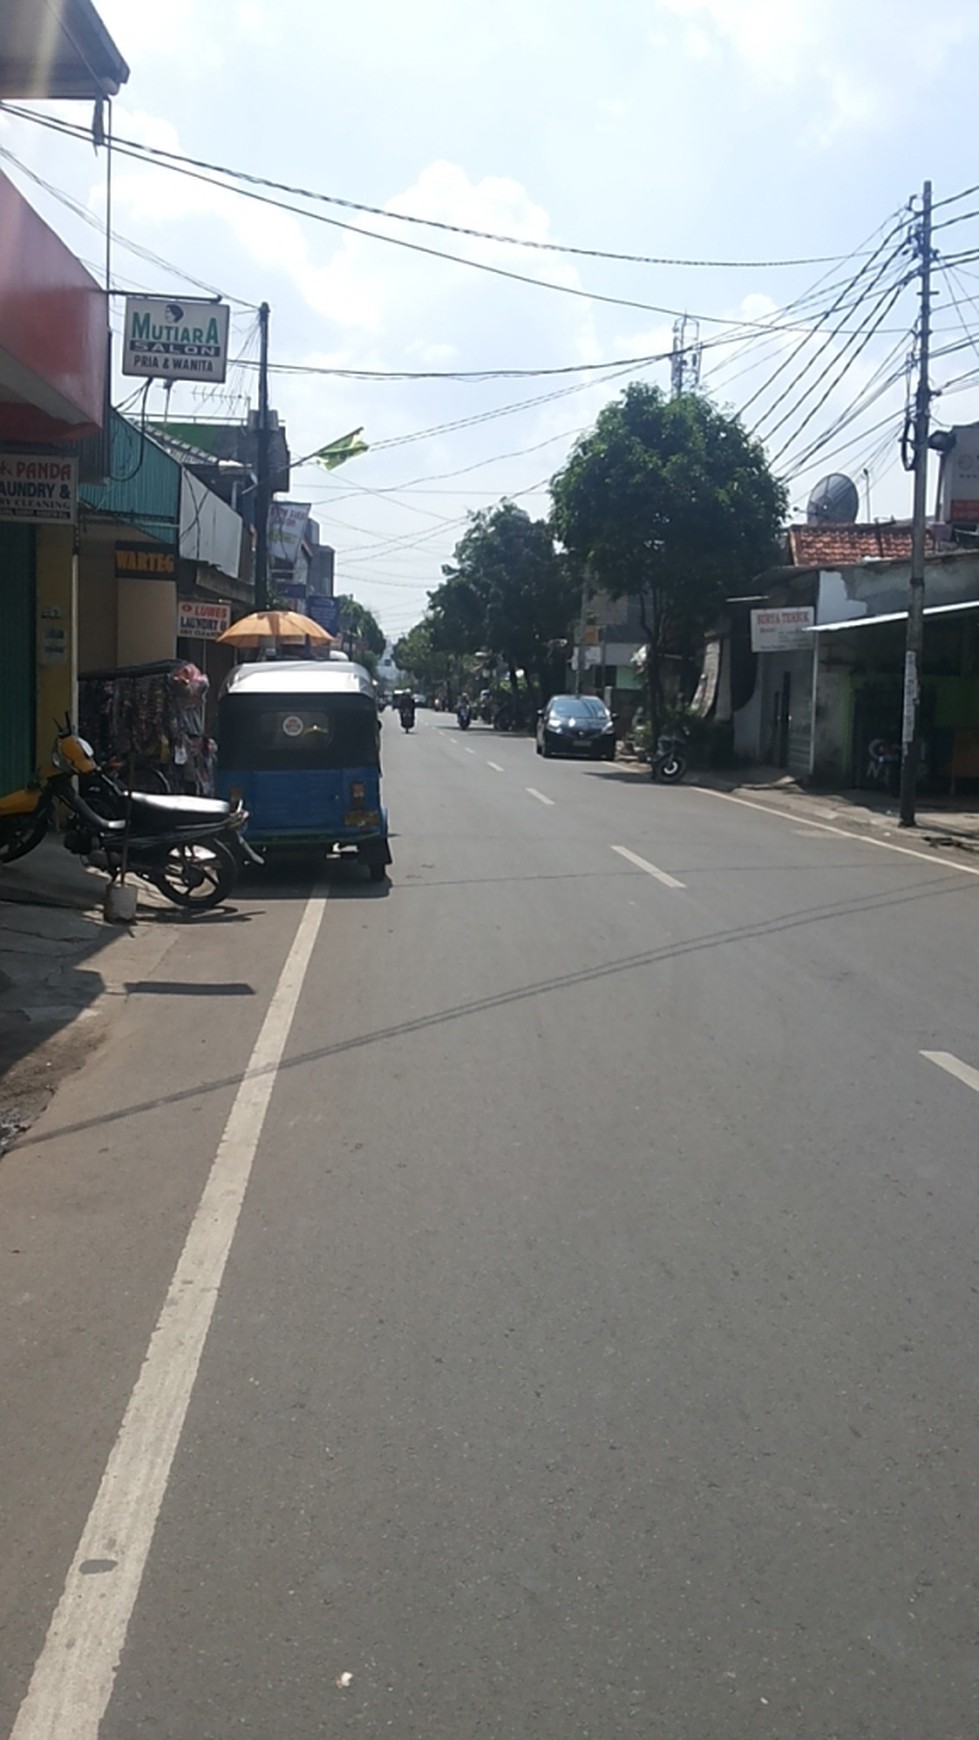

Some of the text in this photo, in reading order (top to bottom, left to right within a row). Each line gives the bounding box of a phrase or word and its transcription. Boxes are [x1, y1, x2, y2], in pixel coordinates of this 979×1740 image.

[131, 311, 219, 345] MUTIARA
[134, 341, 215, 357] SALON
[134, 354, 213, 372] PRIA & WANITA
[16, 461, 71, 481] PANDA
[59, 483, 71, 499] &
[115, 550, 175, 573] WARTEG
